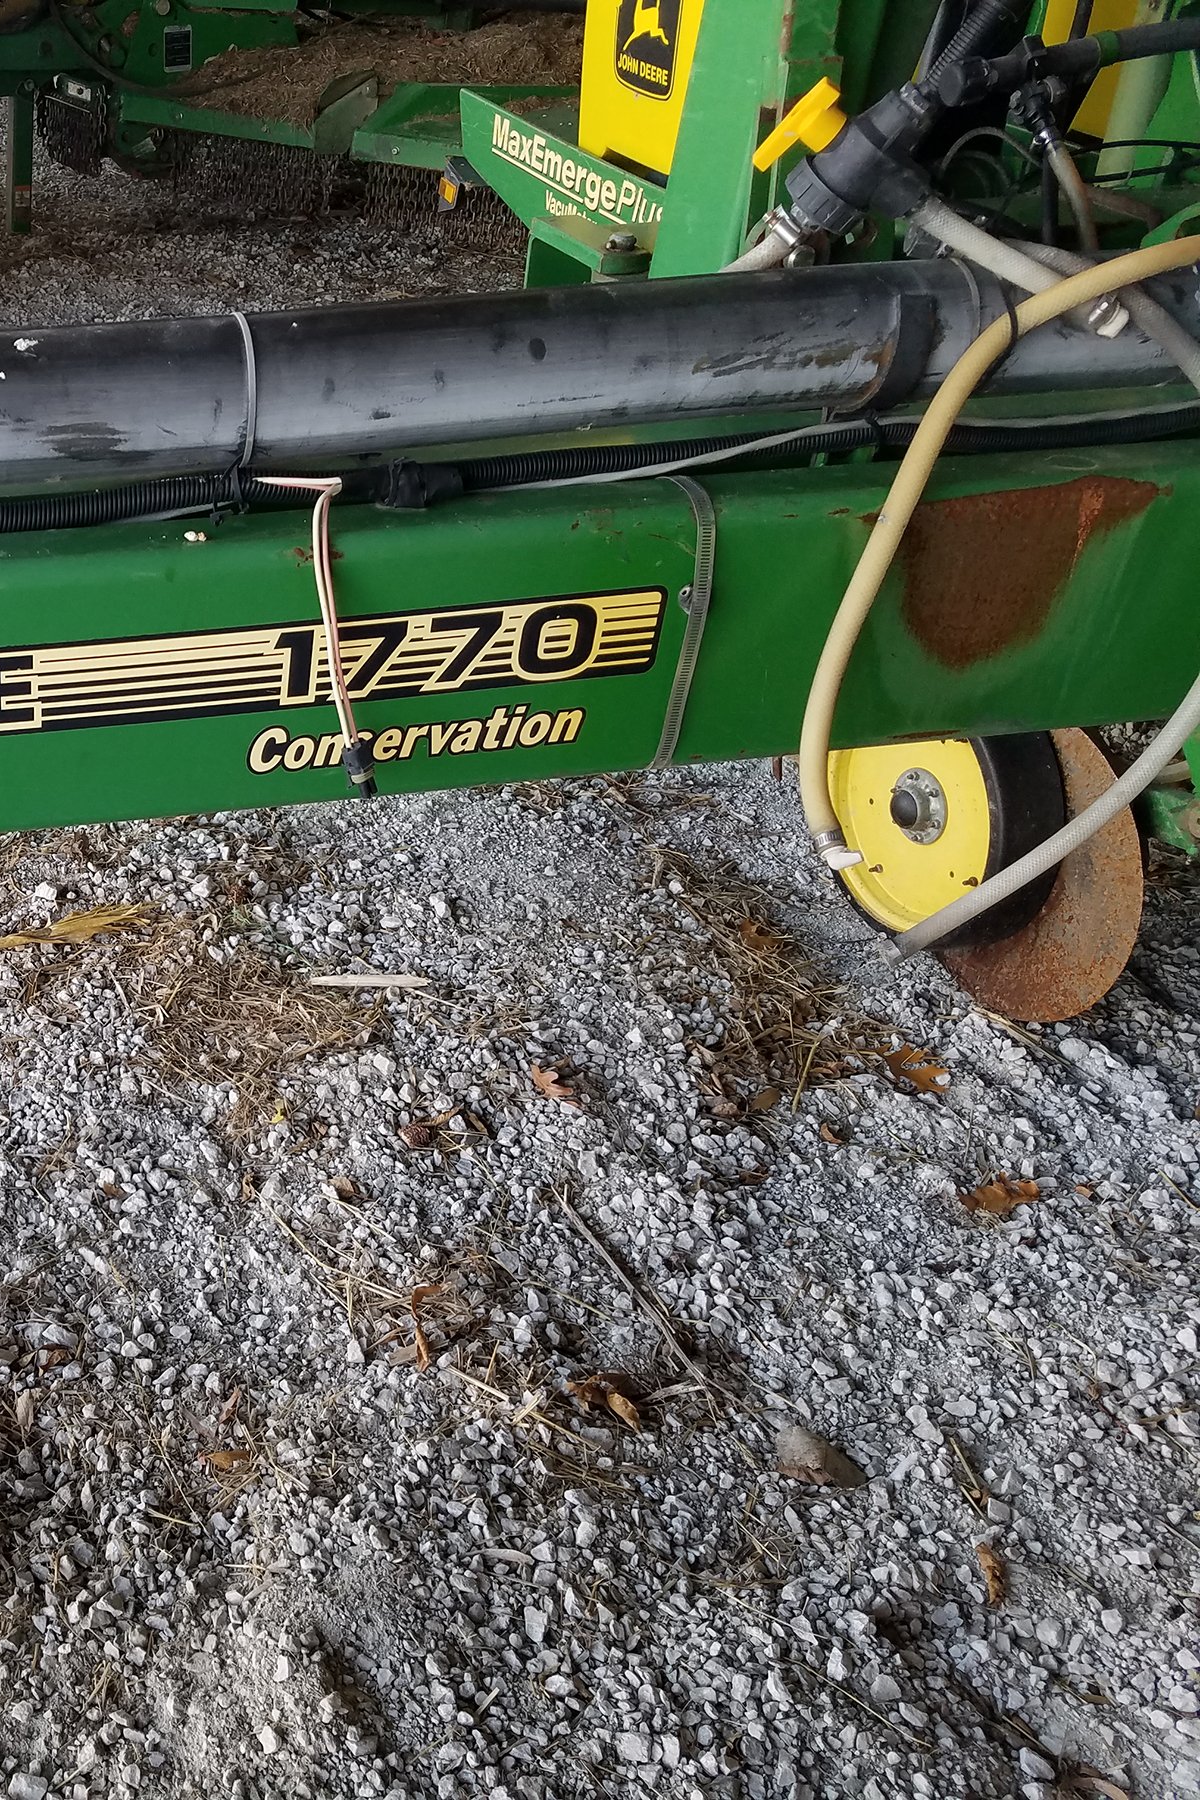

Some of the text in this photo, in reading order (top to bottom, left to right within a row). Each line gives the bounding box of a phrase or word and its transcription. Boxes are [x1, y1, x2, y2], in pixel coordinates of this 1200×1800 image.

[617, 52, 669, 86] JOHN DEERE
[545, 189, 598, 224] VacuM
[273, 603, 600, 703] 1770
